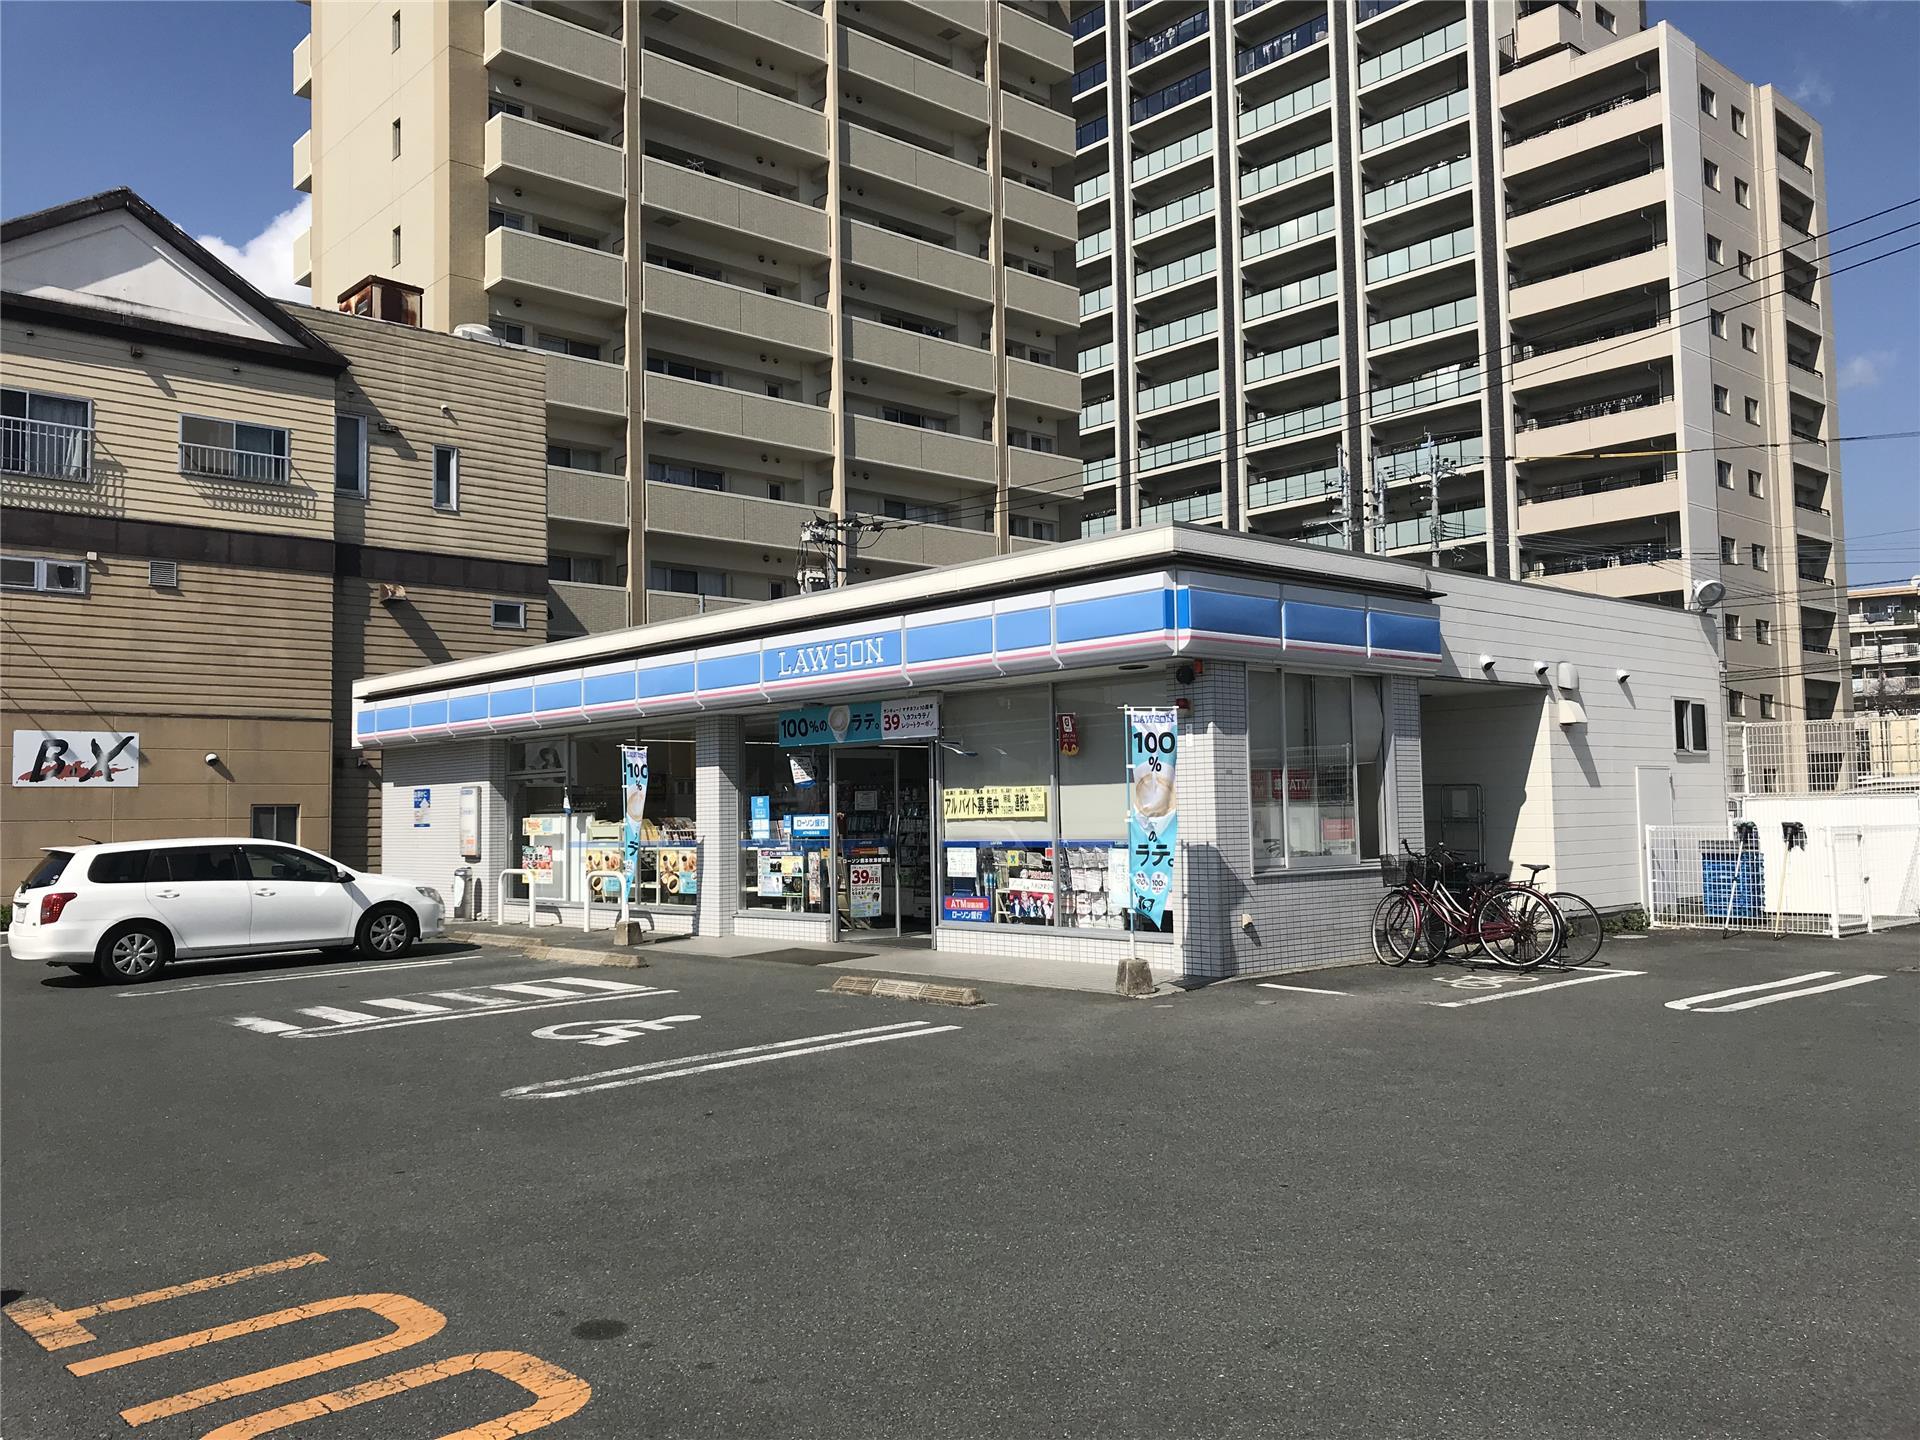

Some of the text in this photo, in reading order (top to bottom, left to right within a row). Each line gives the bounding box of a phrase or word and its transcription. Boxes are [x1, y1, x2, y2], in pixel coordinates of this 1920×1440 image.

[779, 637, 884, 676] LAWSON
[883, 714, 900, 731] 39
[1133, 713, 1175, 723] LAWSON
[1133, 732, 1175, 753] 100
[952, 911, 982, 920] ローソン銀行
